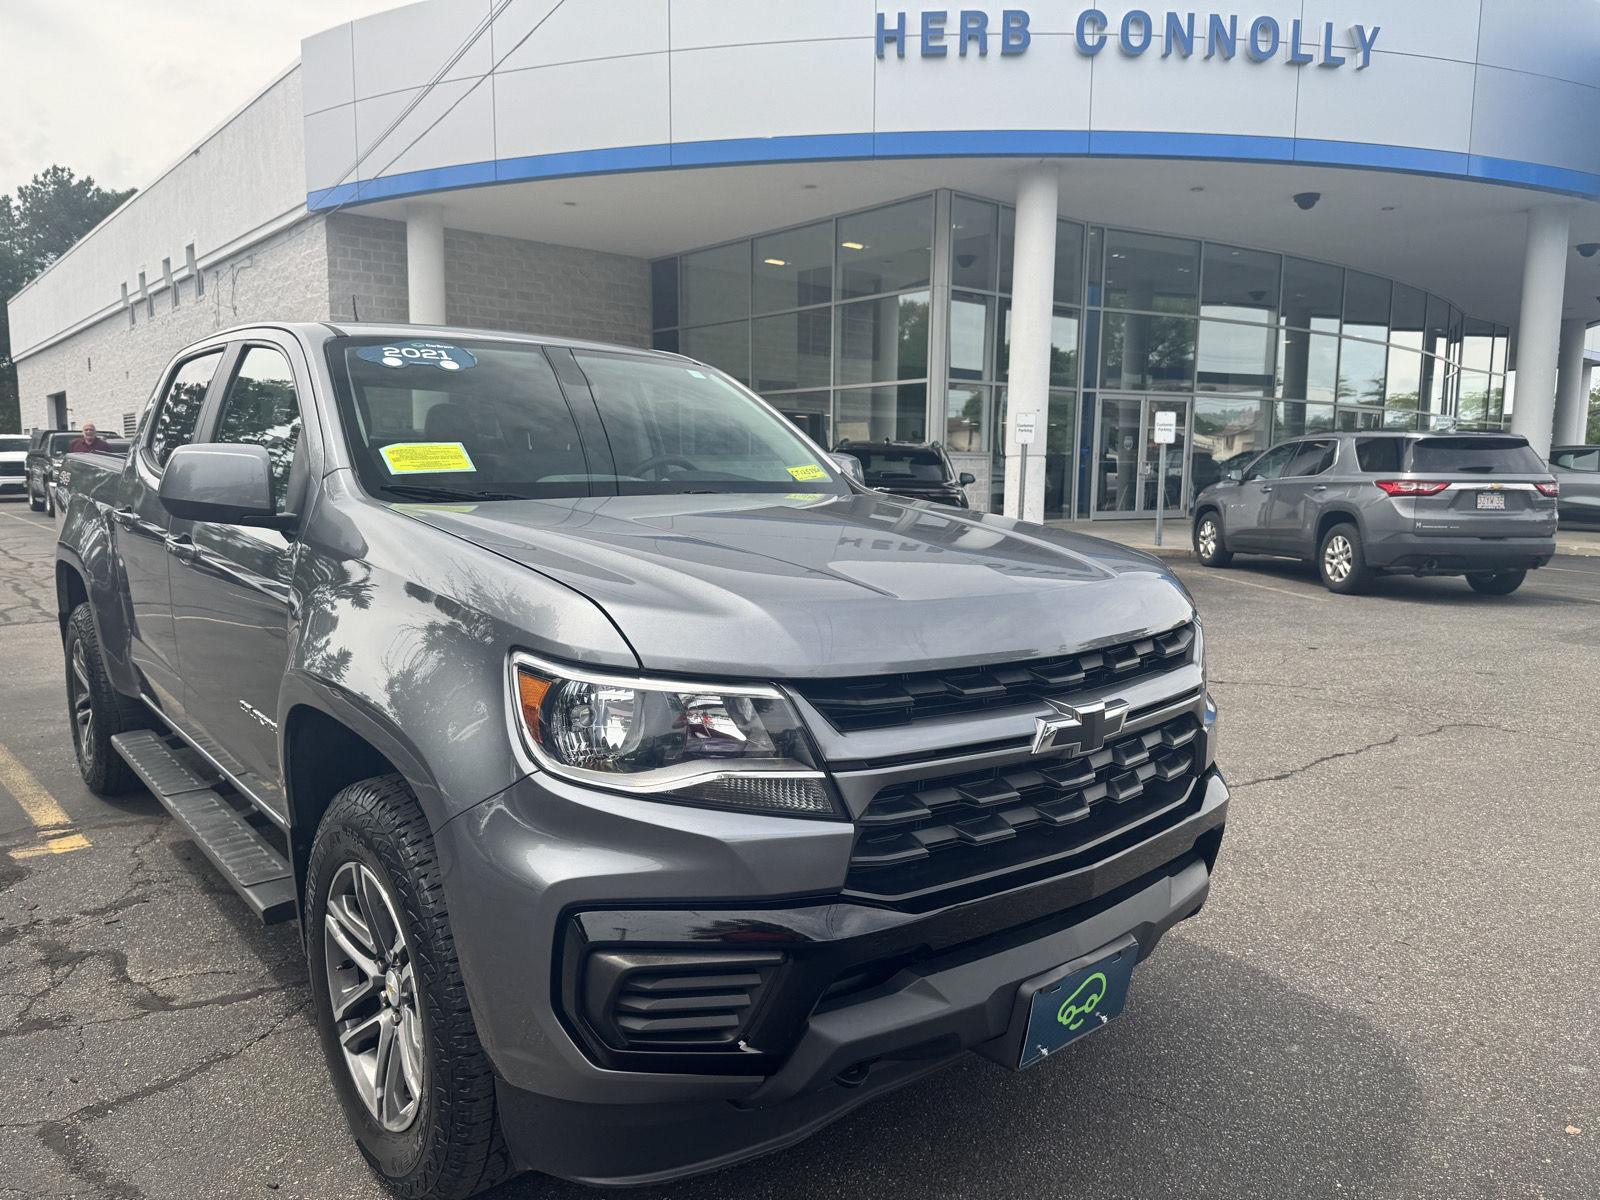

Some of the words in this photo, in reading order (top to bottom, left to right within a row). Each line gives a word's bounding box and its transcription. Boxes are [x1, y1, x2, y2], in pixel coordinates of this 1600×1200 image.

[875, 9, 1032, 58] HERB
[1075, 9, 1382, 70] CONNOLLY
[382, 347, 453, 360] 2021
